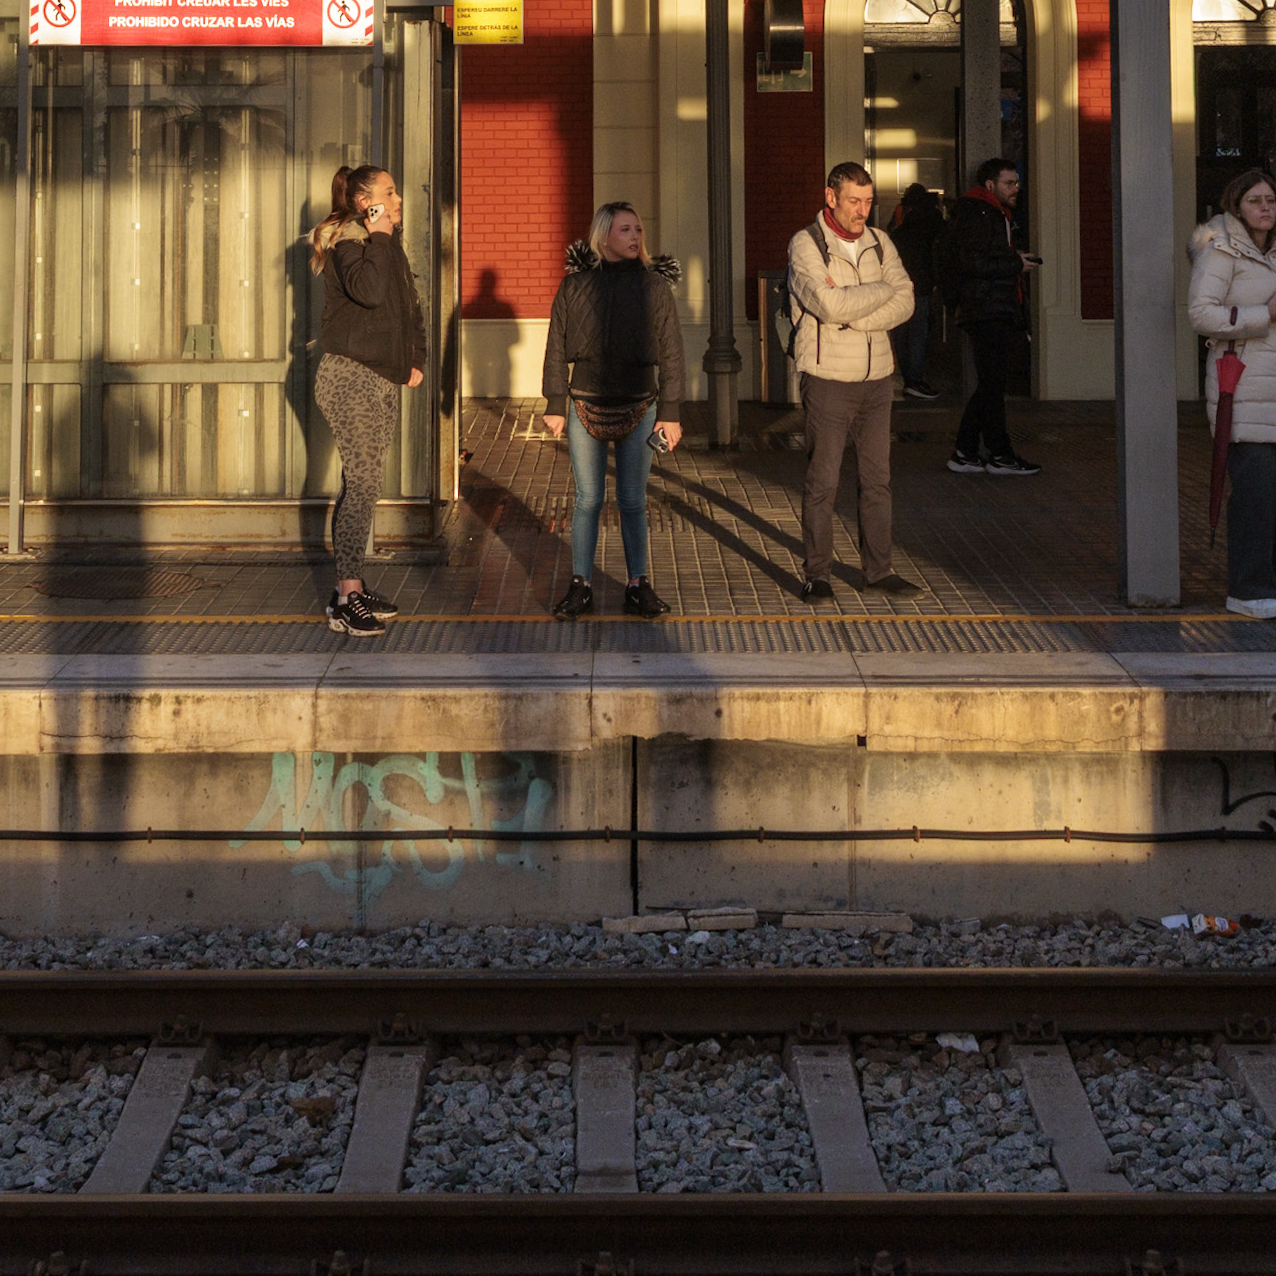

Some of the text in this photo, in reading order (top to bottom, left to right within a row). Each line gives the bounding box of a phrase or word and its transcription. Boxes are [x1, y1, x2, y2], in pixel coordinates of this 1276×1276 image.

[109, 14, 295, 28] PROHIBIDO CRUZAR LAS VÍAS
